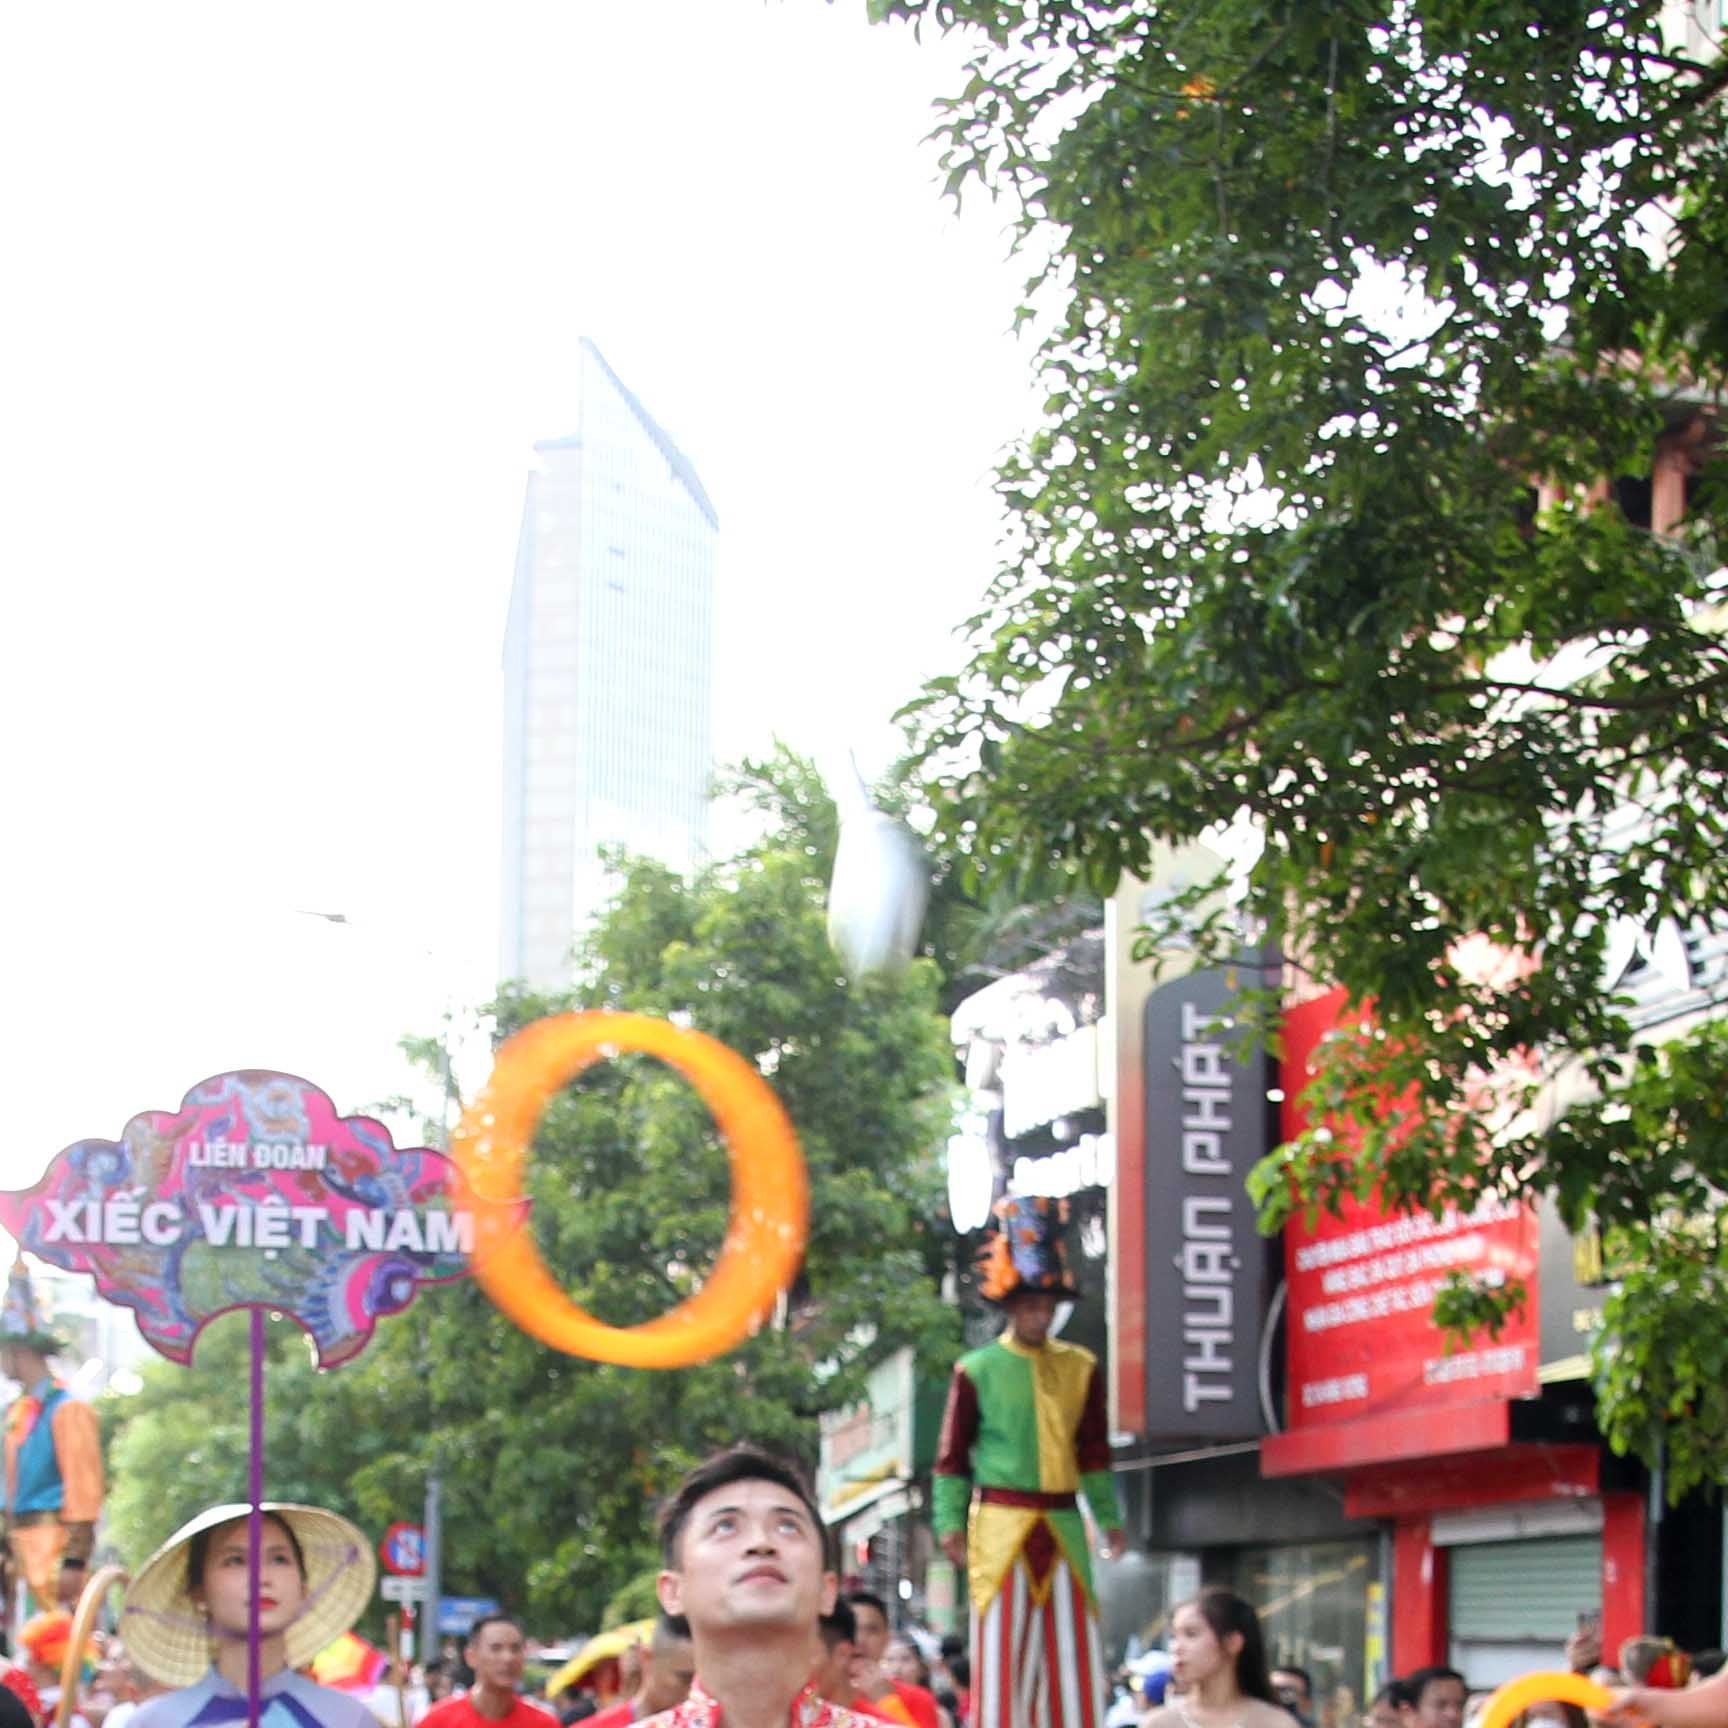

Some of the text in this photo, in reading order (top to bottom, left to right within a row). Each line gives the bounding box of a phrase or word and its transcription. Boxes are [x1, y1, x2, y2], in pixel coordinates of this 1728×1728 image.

[189, 1136, 249, 1169] LIÊN
[45, 1186, 473, 1260] XIẾC VIỆT NAM
[1172, 1002, 1241, 1412] THUẬN PHÁT
